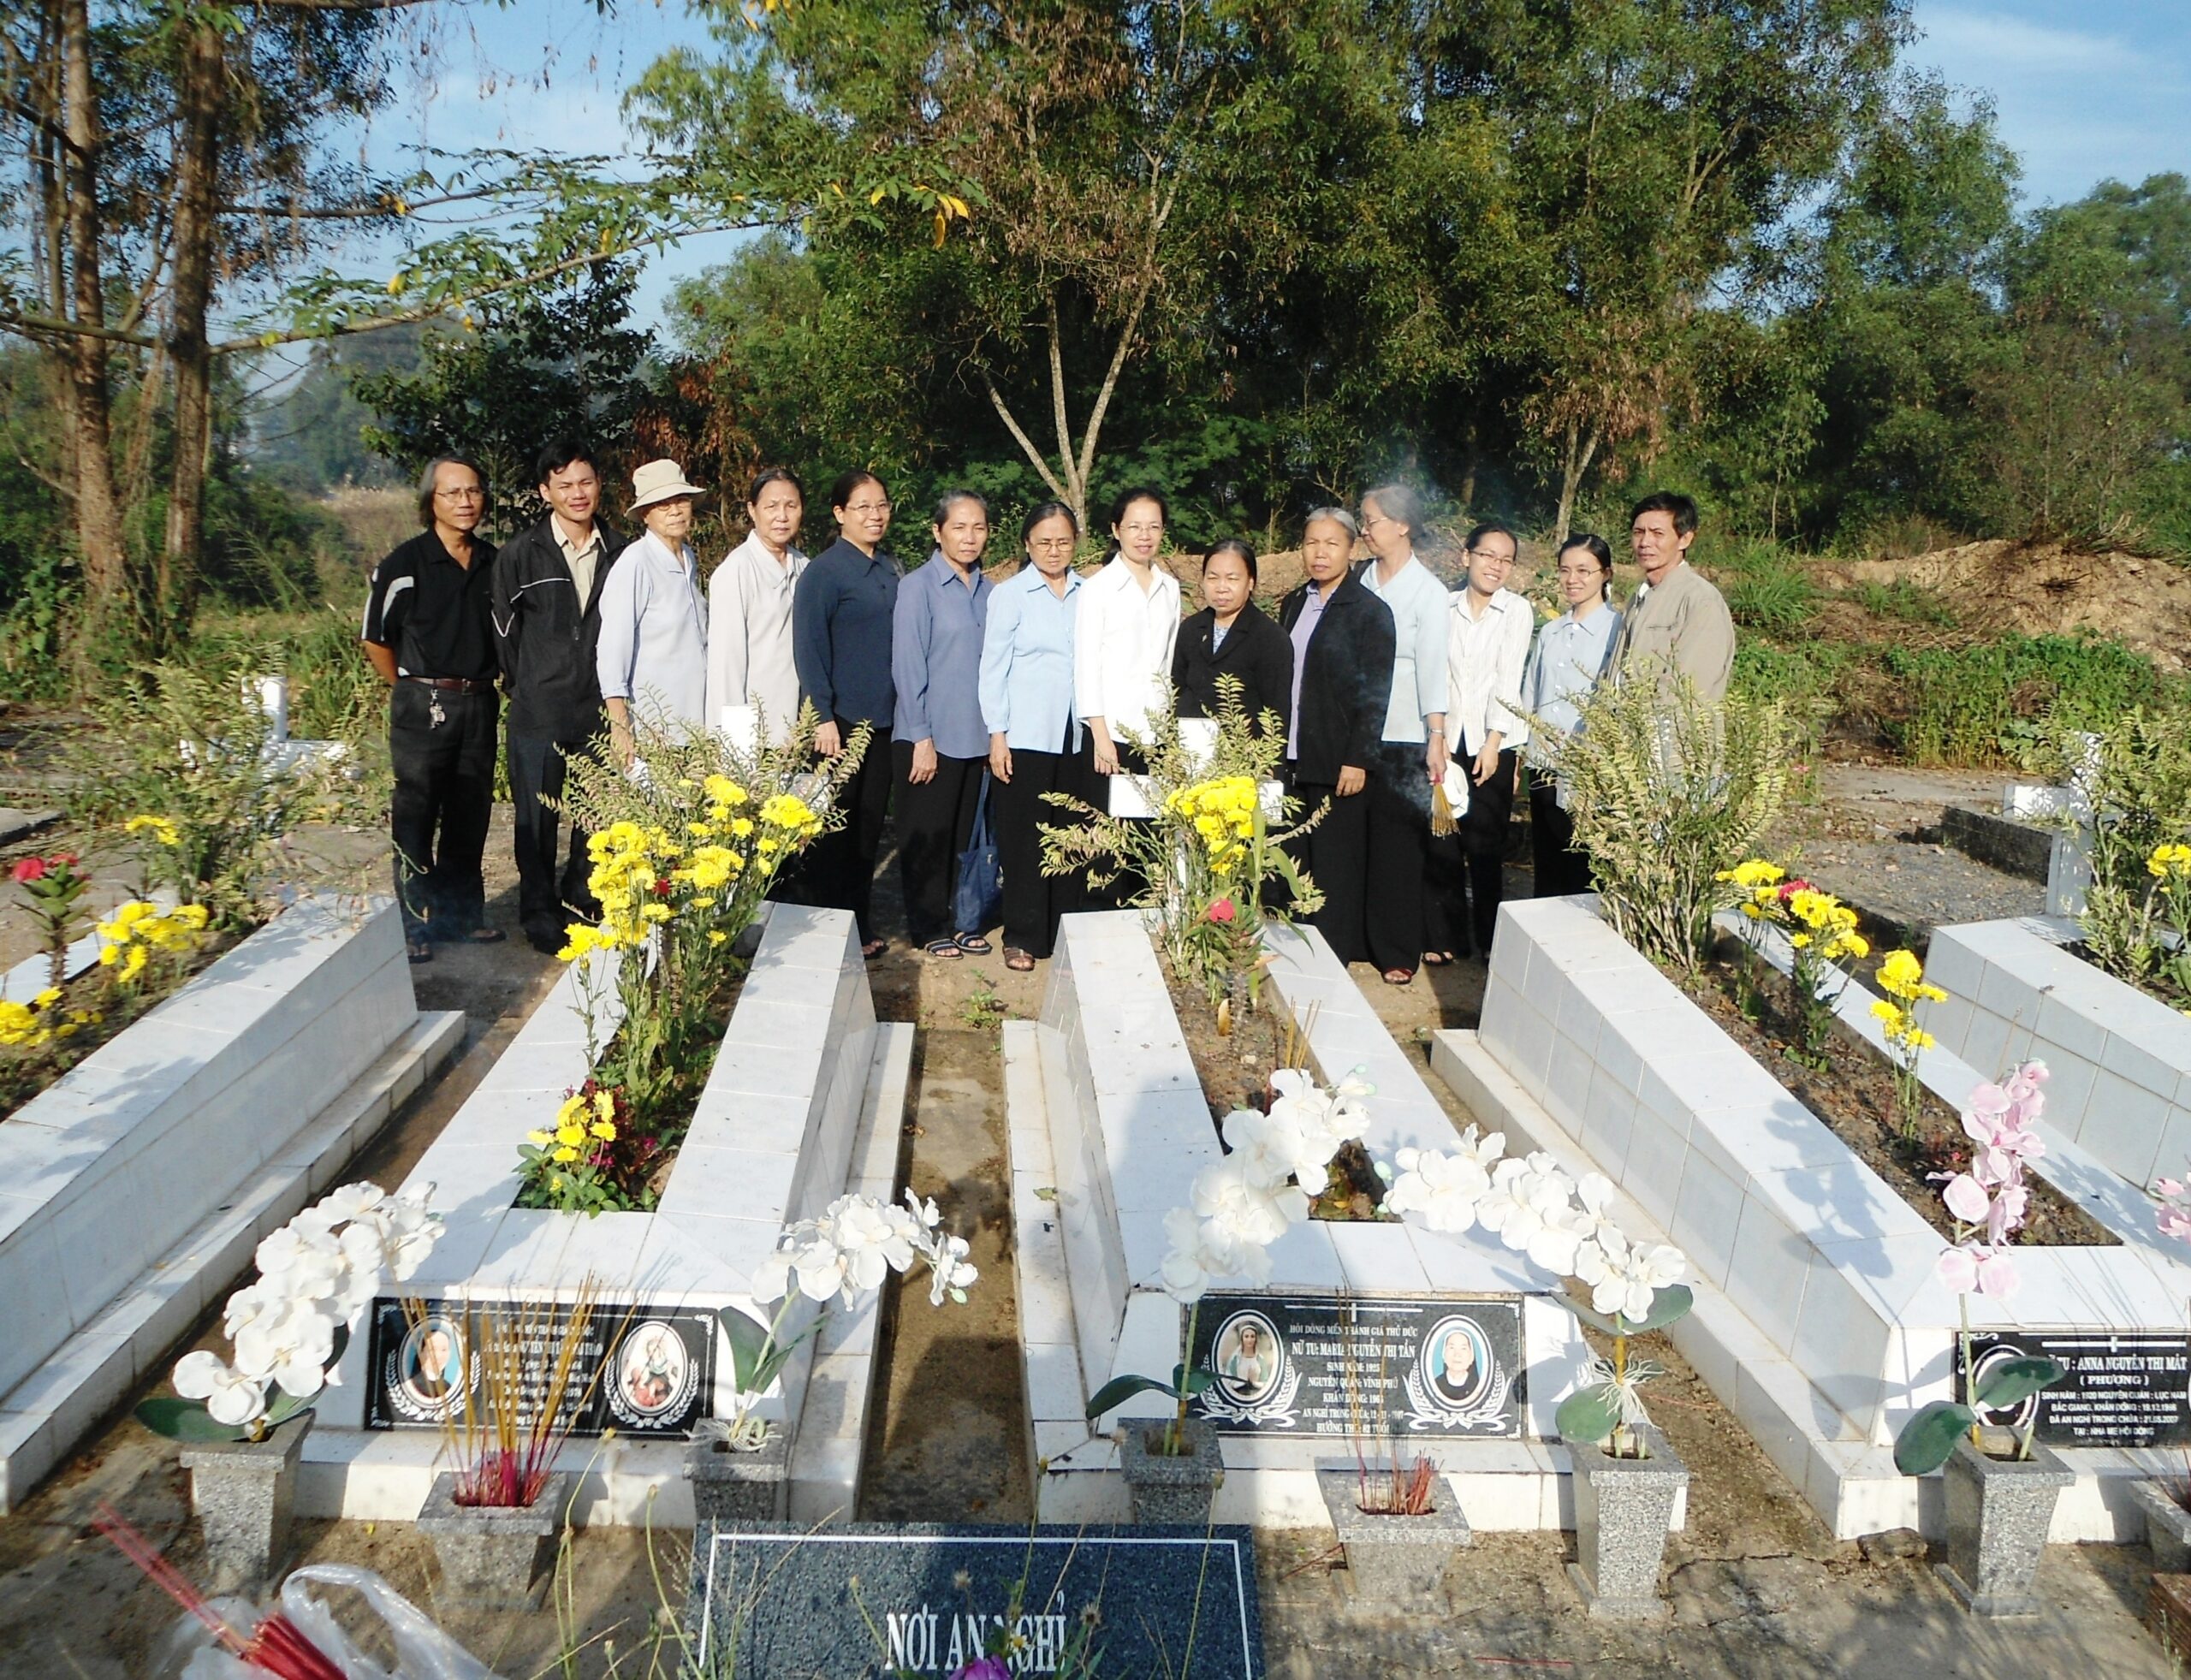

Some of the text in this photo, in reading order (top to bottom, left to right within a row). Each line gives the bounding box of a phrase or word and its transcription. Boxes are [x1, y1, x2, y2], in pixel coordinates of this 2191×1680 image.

[1291, 1339, 1305, 1355] NỮ
[1320, 1342, 1345, 1356] MARIA
[1327, 1362, 1345, 1372] SINH
[2077, 1356, 2104, 1370] ANNA
[2146, 1356, 2164, 1374] THỊ
[2041, 1392, 2058, 1400] SINH
[2170, 1391, 2187, 1400] NAM
[1329, 1408, 1349, 1418] TRONG
[2061, 1415, 2072, 1423] AN
[2092, 1415, 2117, 1423] TRONG
[885, 1589, 1067, 1673] NƠI AN GHỈ
